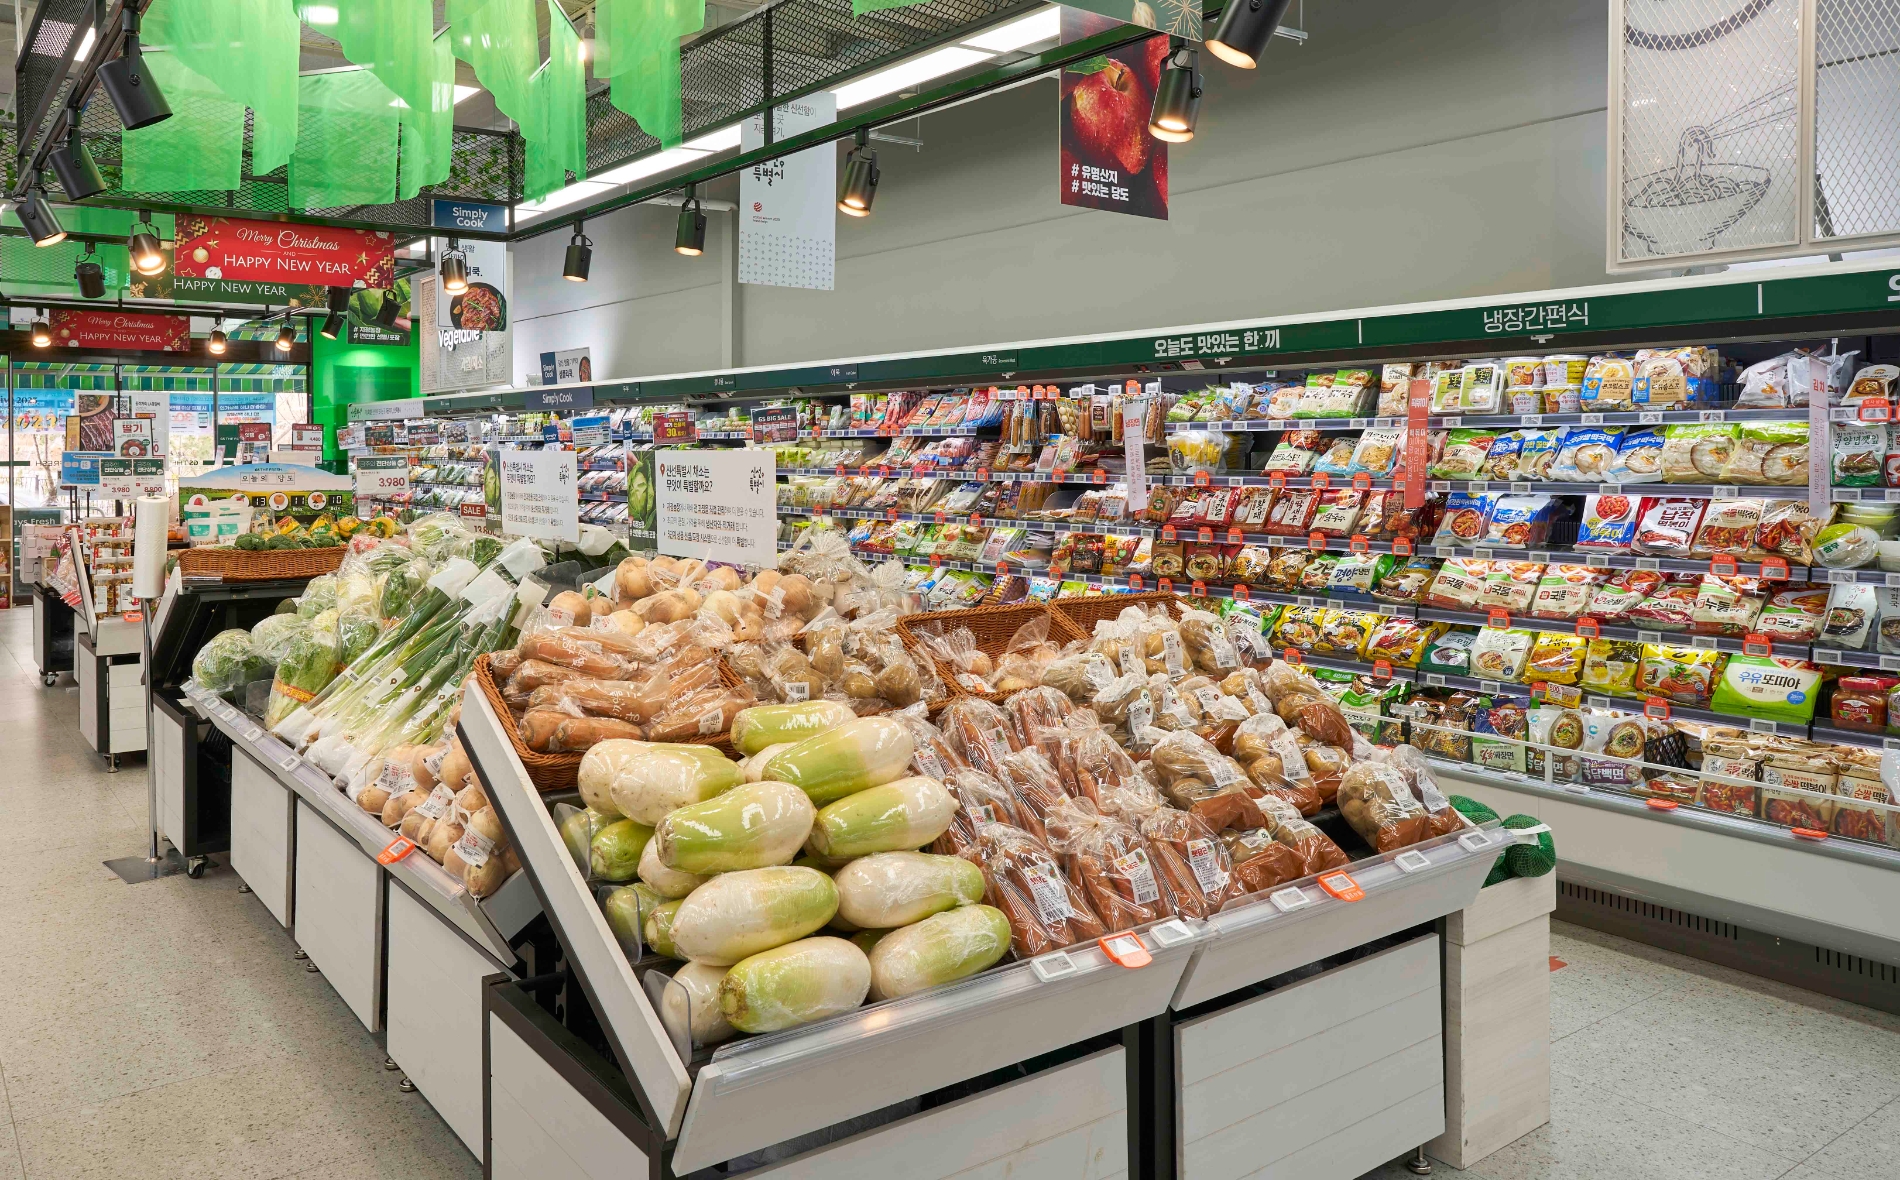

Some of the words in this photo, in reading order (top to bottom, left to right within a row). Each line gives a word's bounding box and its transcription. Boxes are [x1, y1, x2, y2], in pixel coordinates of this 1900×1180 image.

[752, 169, 784, 186] 특별시
[1082, 166, 1118, 184] 유명산지
[1082, 182, 1109, 198] 맛있는
[1111, 186, 1129, 202] 당도
[452, 206, 488, 222] Simply
[456, 218, 484, 228] Cook
[236, 228, 273, 246] Merry
[278, 229, 340, 250] Christmas
[224, 254, 272, 269] HAPPY
[277, 258, 311, 272] NEW
[316, 260, 351, 274] YEAR
[174, 278, 216, 291] HAPPY
[222, 282, 252, 294] NEW
[256, 284, 286, 296] YEAR
[88, 316, 111, 326] Merry
[114, 316, 154, 328] Christmas
[1483, 302, 1588, 332] 냉장간편식
[80, 332, 110, 340] HAPPY
[114, 333, 136, 342] NEW
[139, 334, 162, 342] YEAR
[1154, 337, 1194, 358] 오늘도
[1198, 334, 1240, 354] 맛있는
[1244, 330, 1260, 350] 한
[1264, 329, 1280, 348] 끼
[543, 364, 554, 372] Simply
[1813, 378, 1824, 394] 김치
[542, 394, 559, 405] Simply
[560, 393, 572, 402] Cook
[122, 424, 142, 434] 딸기
[666, 464, 692, 478] 신선특별시
[692, 465, 710, 478] 채소는
[750, 466, 764, 478] 신선
[378, 478, 405, 487] 3,980
[666, 480, 682, 492] 무엇이
[683, 480, 713, 493] 특별할까요?
[254, 497, 266, 506] 13
[292, 496, 304, 504] 11
[330, 496, 342, 504] 10
[463, 506, 480, 515] SALE
[1661, 510, 1695, 521] 납작
[1335, 567, 1358, 583] 평양
[1738, 672, 1762, 684] 우유
[1762, 674, 1801, 690] 또띠아
[1592, 768, 1626, 780] 담백면
[1800, 781, 1827, 794] 떡볶이
[1854, 789, 1872, 800] 순쌀
